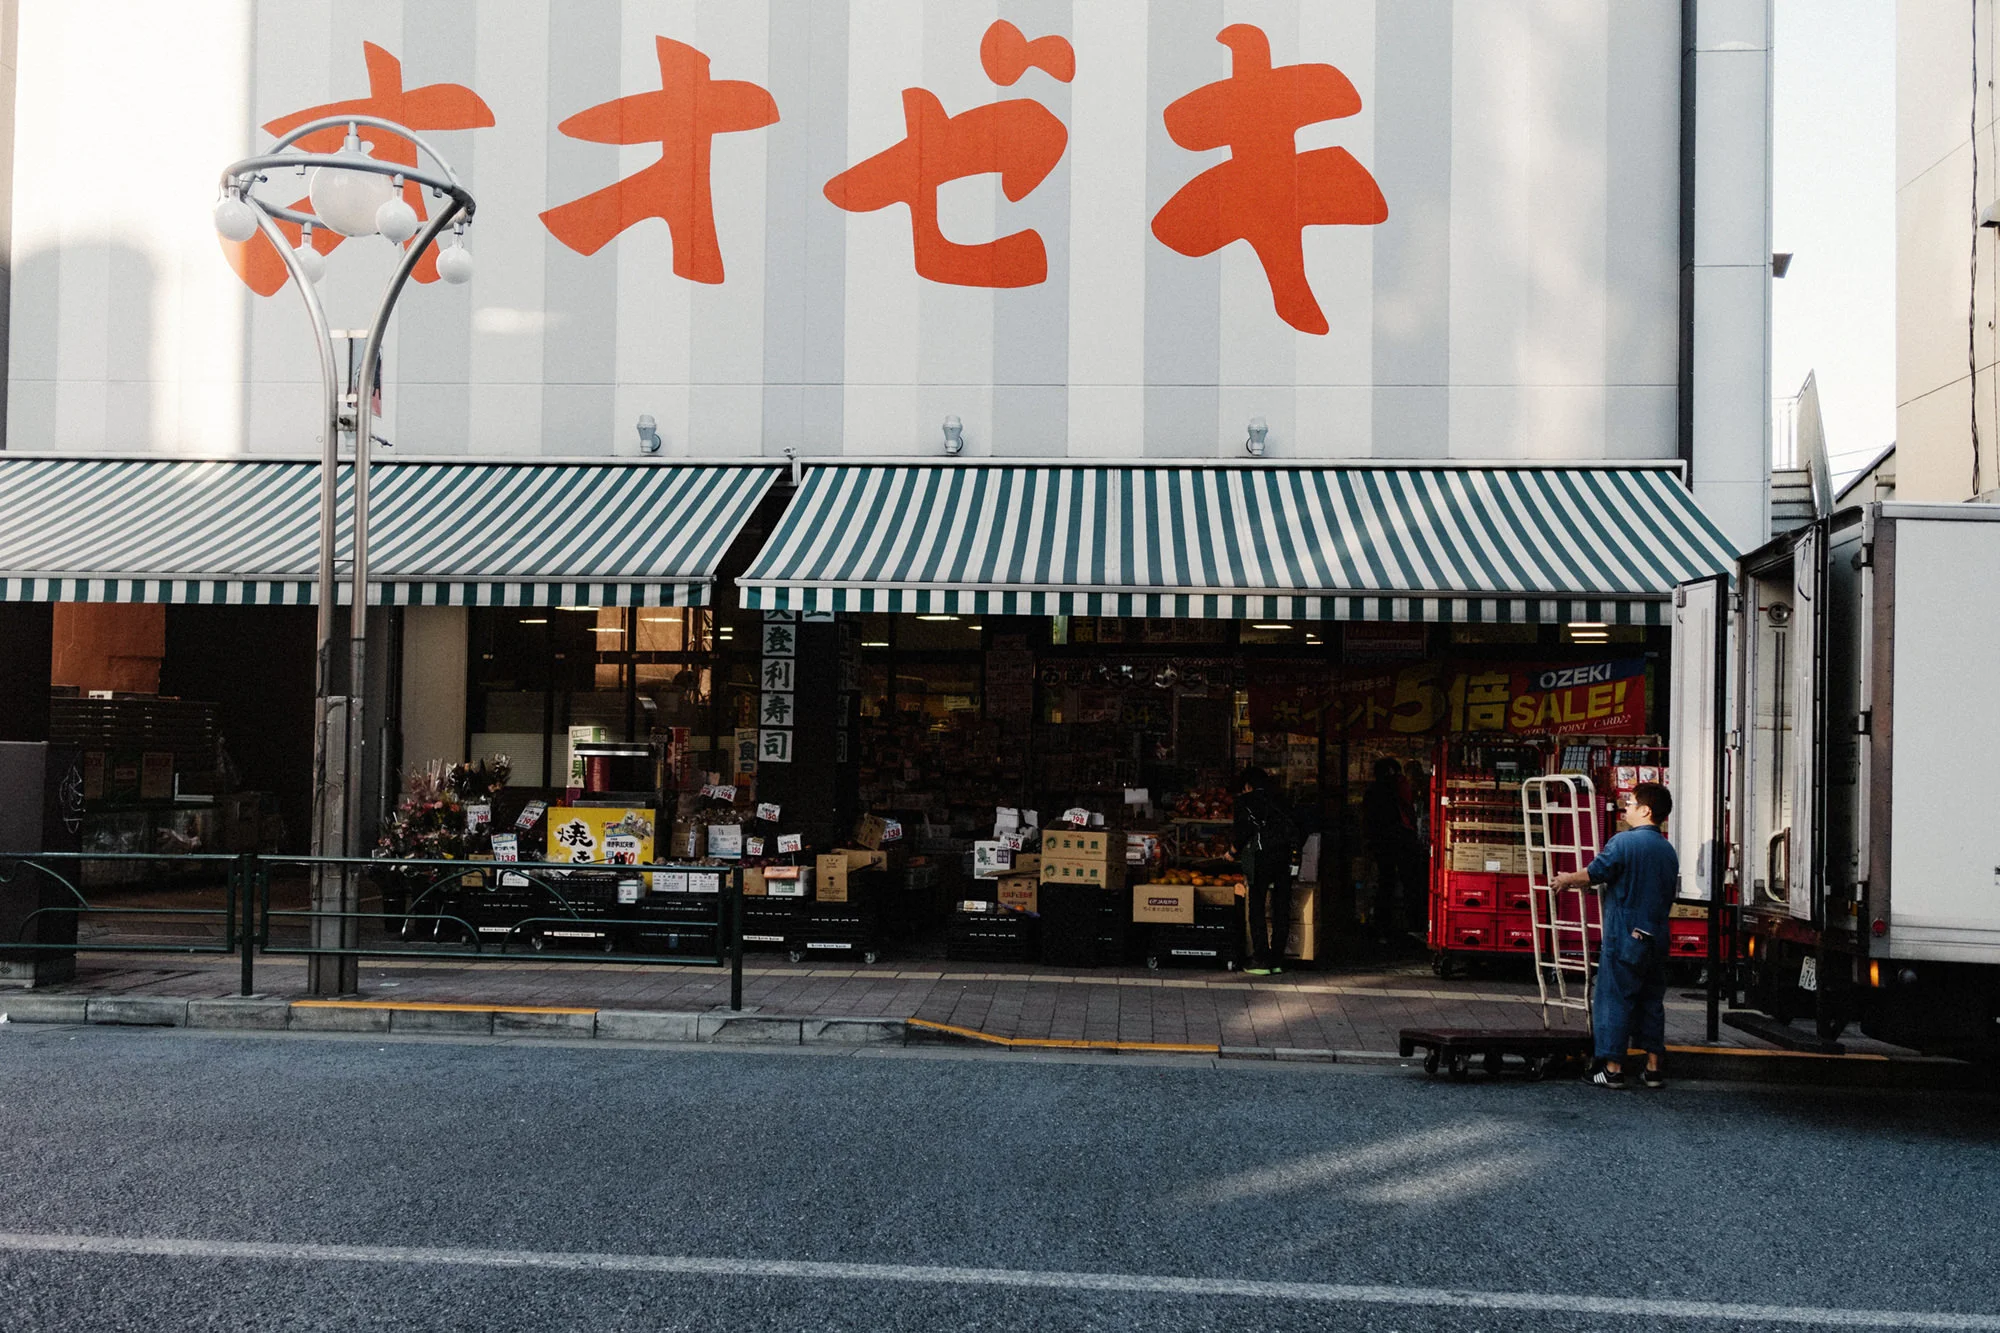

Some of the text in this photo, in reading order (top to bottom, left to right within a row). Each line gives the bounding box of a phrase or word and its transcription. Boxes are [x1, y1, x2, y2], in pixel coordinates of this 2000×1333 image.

[219, 20, 1387, 334] オオゼキ
[1539, 662, 1613, 689] OZEKI
[1511, 681, 1628, 729] SALE!
[1557, 723, 1588, 735] POINT
[476, 814, 489, 823] 198
[765, 812, 777, 821] 150
[1072, 815, 1085, 825] 198
[1008, 840, 1020, 849] 150
